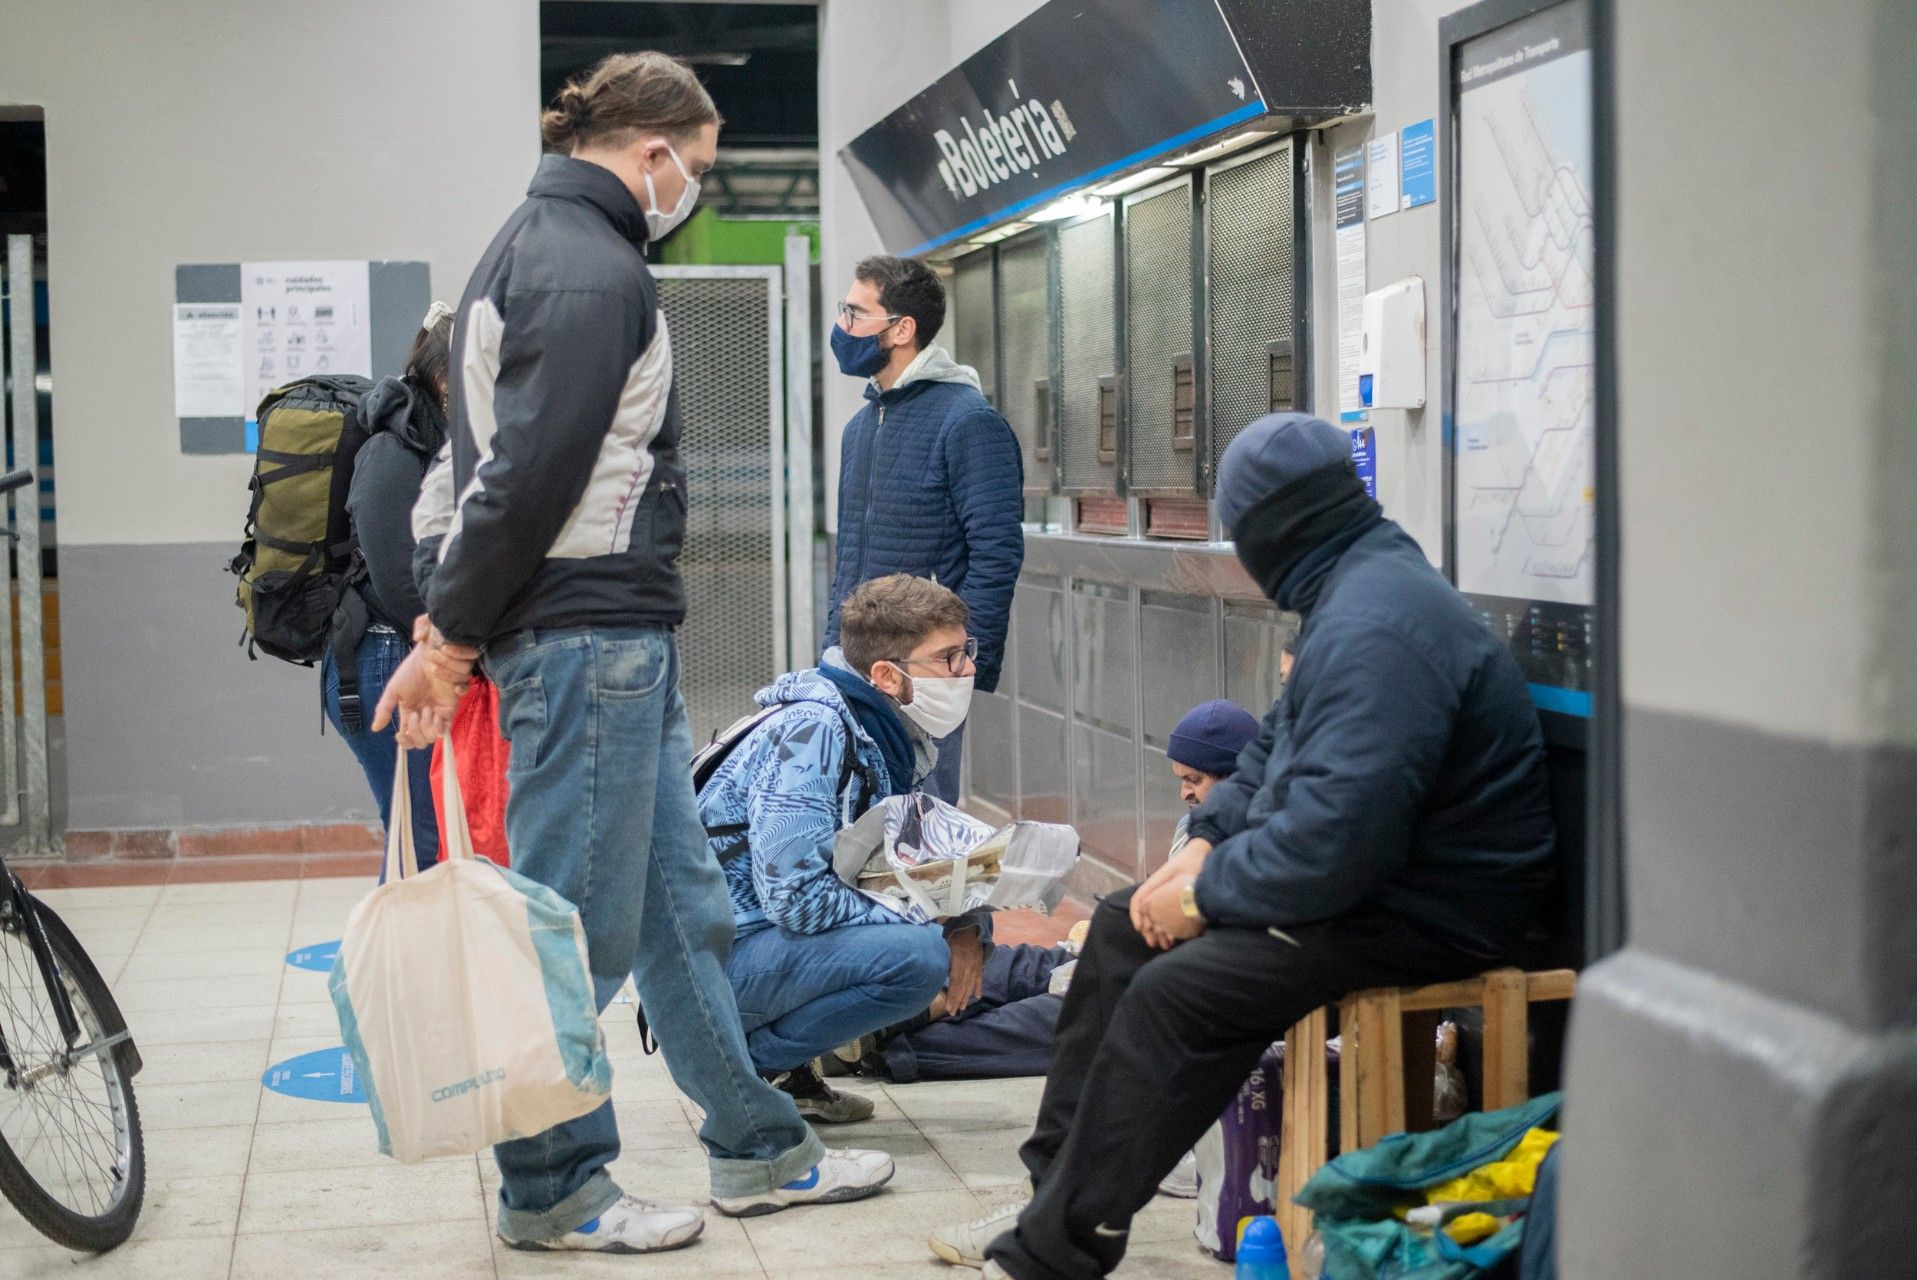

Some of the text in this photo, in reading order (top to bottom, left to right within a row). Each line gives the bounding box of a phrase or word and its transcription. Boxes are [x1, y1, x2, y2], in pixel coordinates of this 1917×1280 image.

[933, 79, 1067, 198] Boletería
[1250, 1067, 1266, 1111] 16 XG
